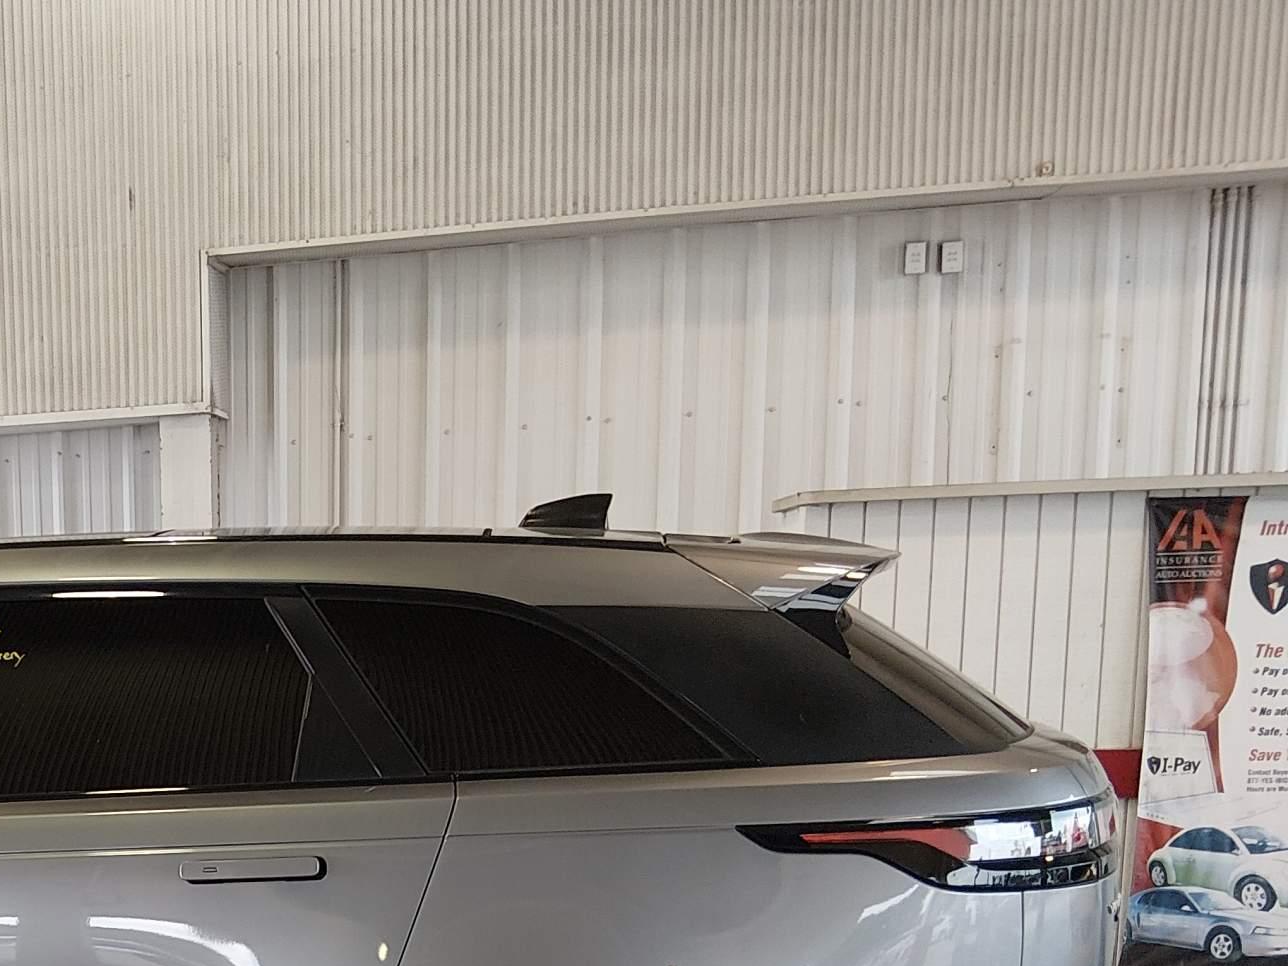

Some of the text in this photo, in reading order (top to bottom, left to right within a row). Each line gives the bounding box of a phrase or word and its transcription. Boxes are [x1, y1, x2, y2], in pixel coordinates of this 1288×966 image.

[1155, 555, 1223, 566] INSURANCE
[1155, 569, 1223, 579] AUTO AUCTIONS
[1256, 643, 1284, 658] The
[1261, 666, 1280, 677] Pay
[1260, 686, 1279, 698] Pay
[1259, 707, 1272, 717] No
[1248, 749, 1282, 761] Save
[1161, 757, 1201, 774] I-Pay
